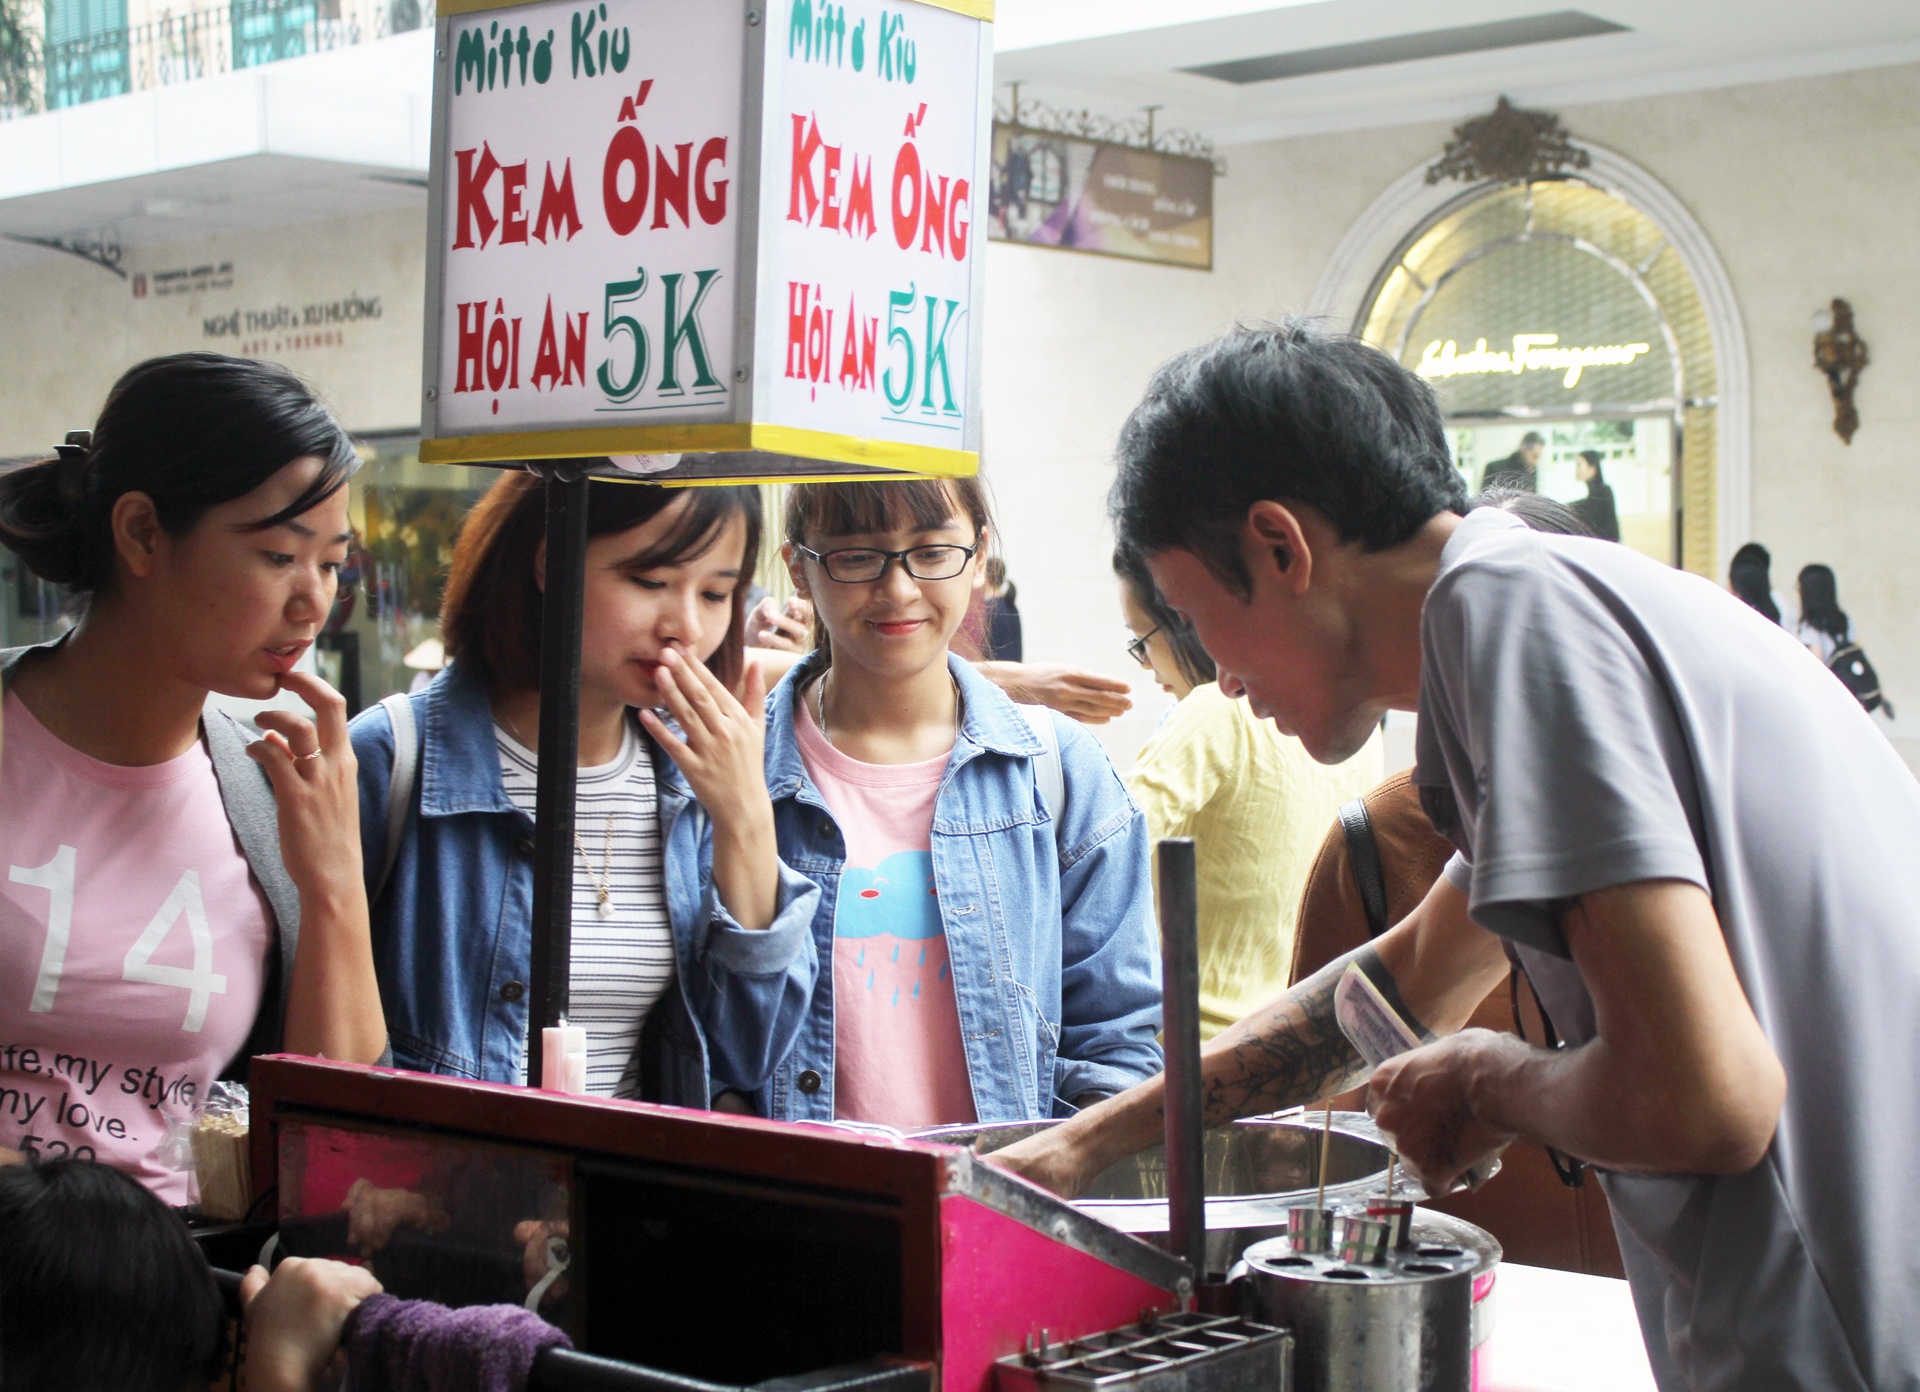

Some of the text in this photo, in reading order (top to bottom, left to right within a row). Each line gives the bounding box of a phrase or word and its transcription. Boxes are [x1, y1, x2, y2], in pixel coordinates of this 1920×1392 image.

[452, 79, 730, 251] KEM ỐNG
[786, 103, 970, 262] KEM ỐNG
[454, 266, 728, 415] HỘI AN 5K
[785, 281, 968, 418] HỘI AN 5K
[8, 844, 227, 1033] 14
[56, 1092, 139, 1142] love.
